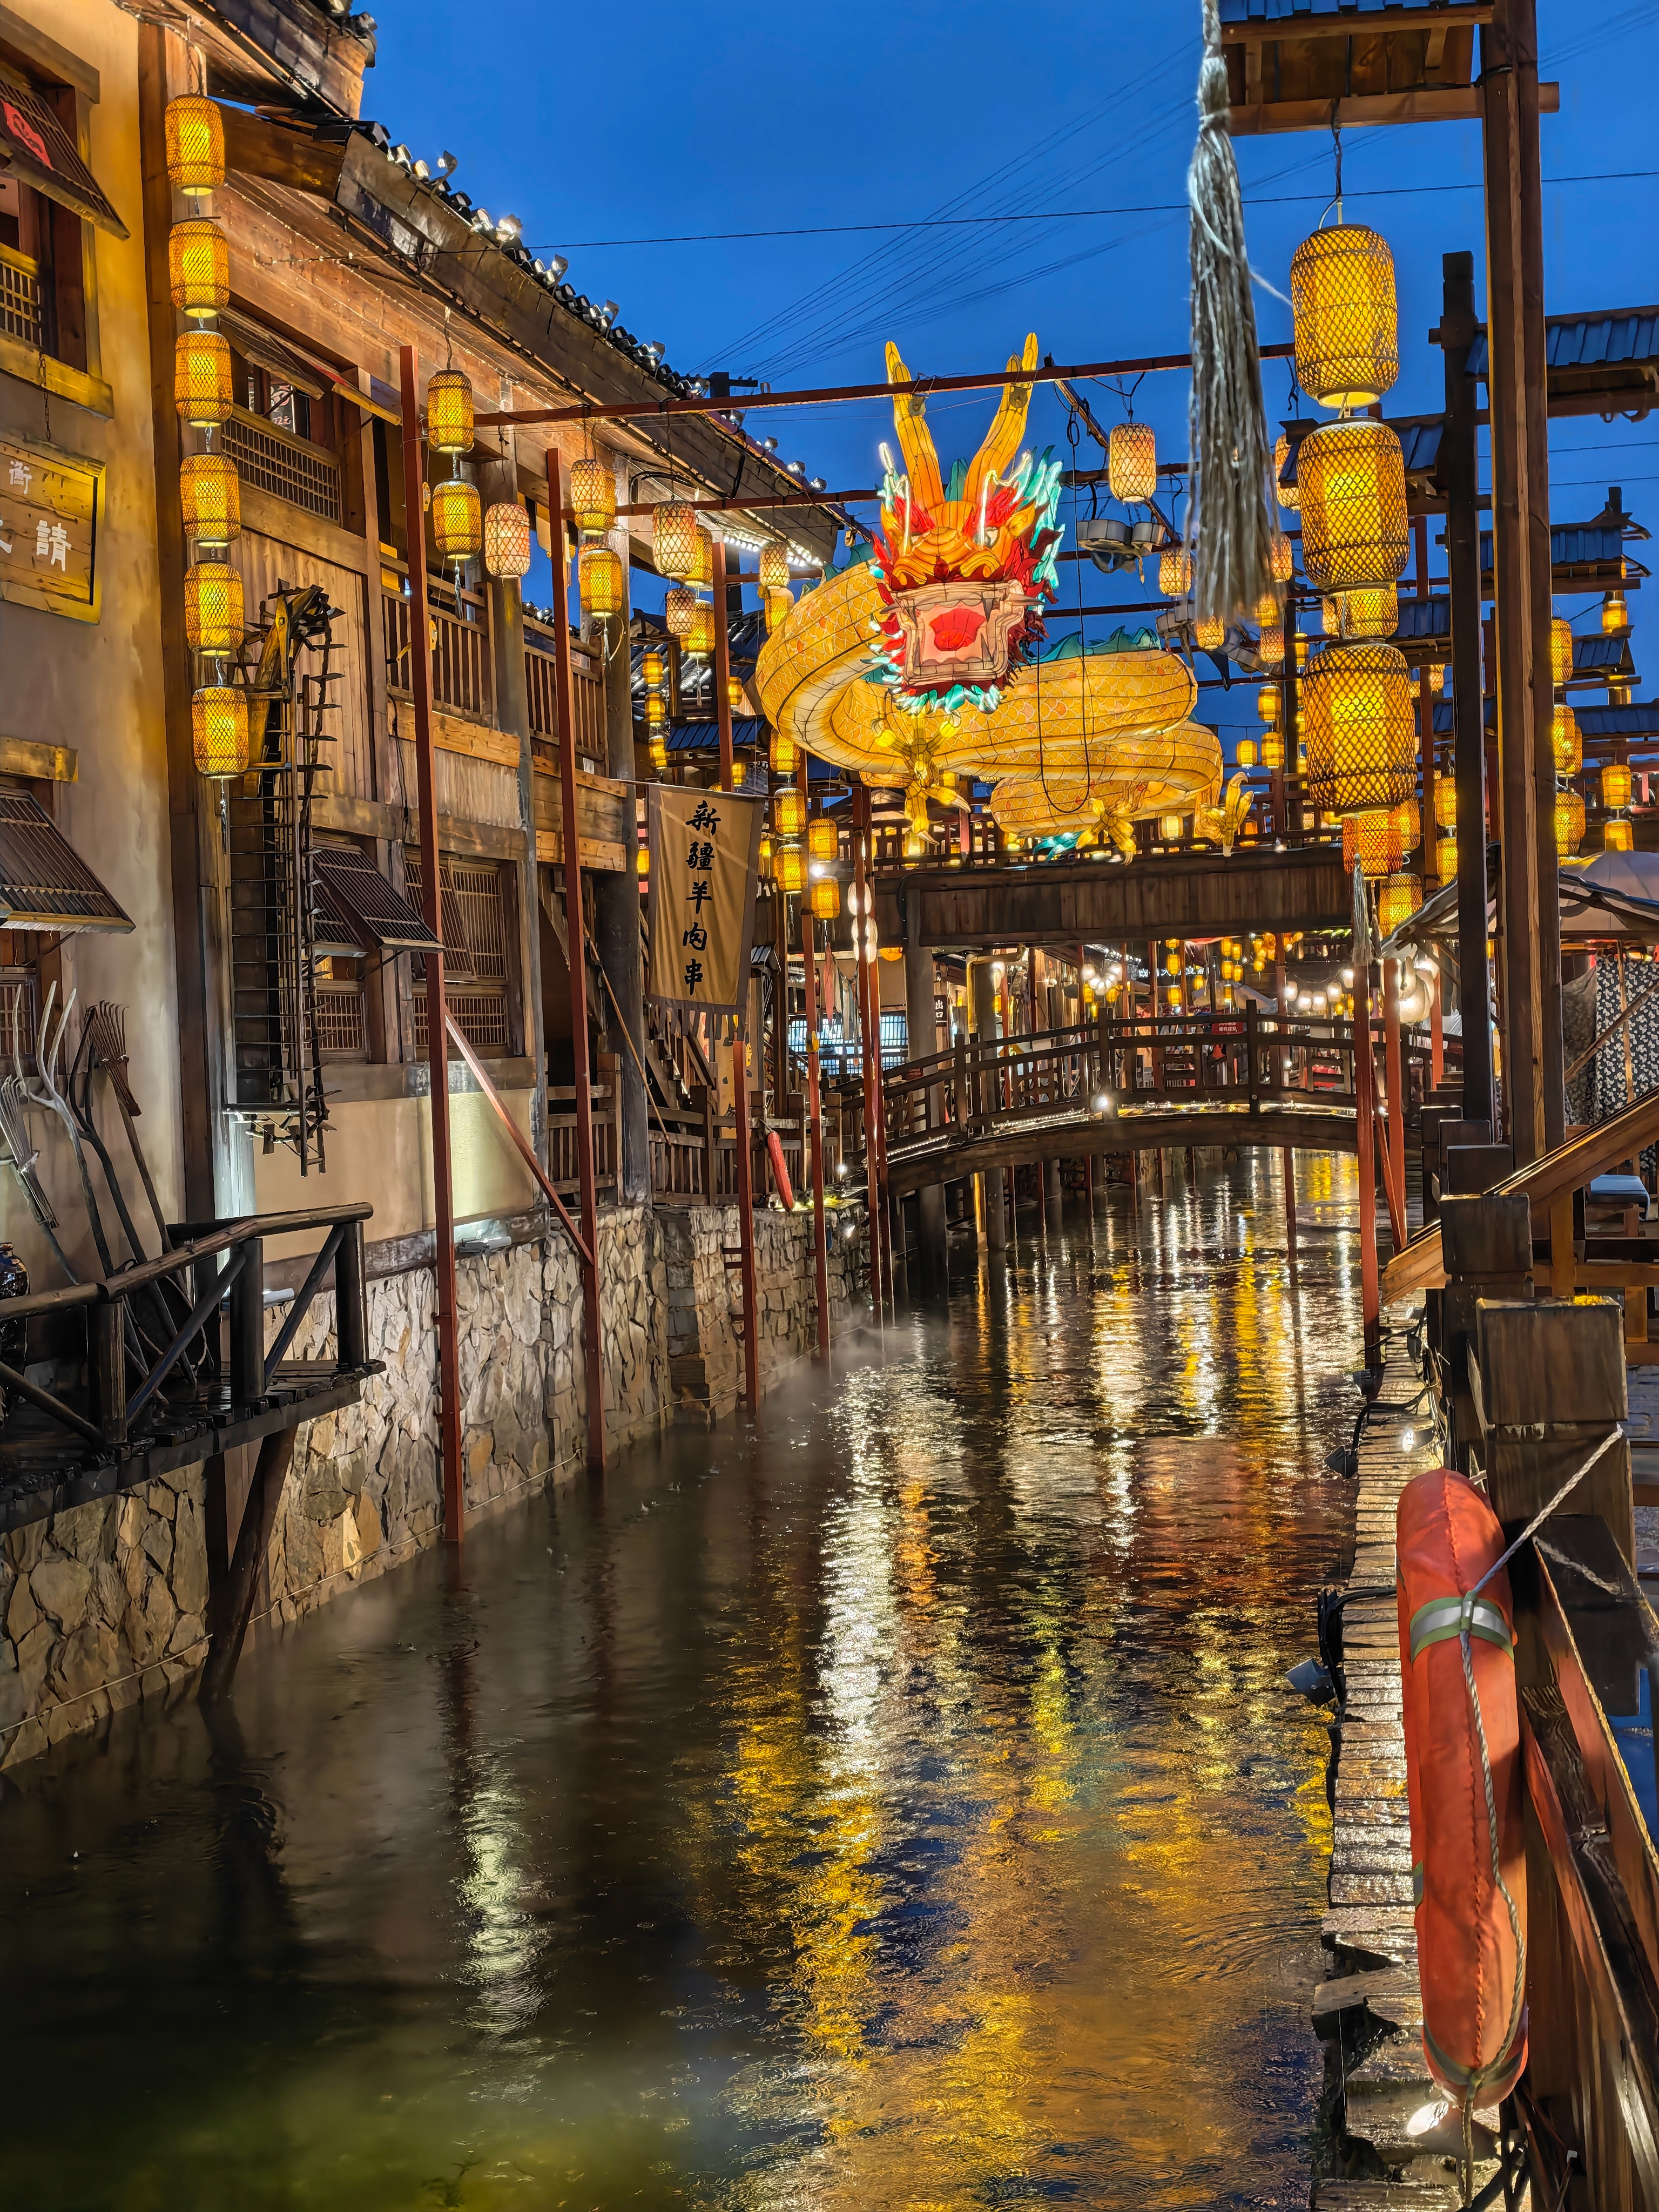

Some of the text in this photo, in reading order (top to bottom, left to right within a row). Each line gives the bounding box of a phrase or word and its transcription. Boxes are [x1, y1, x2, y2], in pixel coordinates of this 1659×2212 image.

[682, 800, 721, 995] 新疆羊肉串
[935, 999, 943, 1018] 出口
